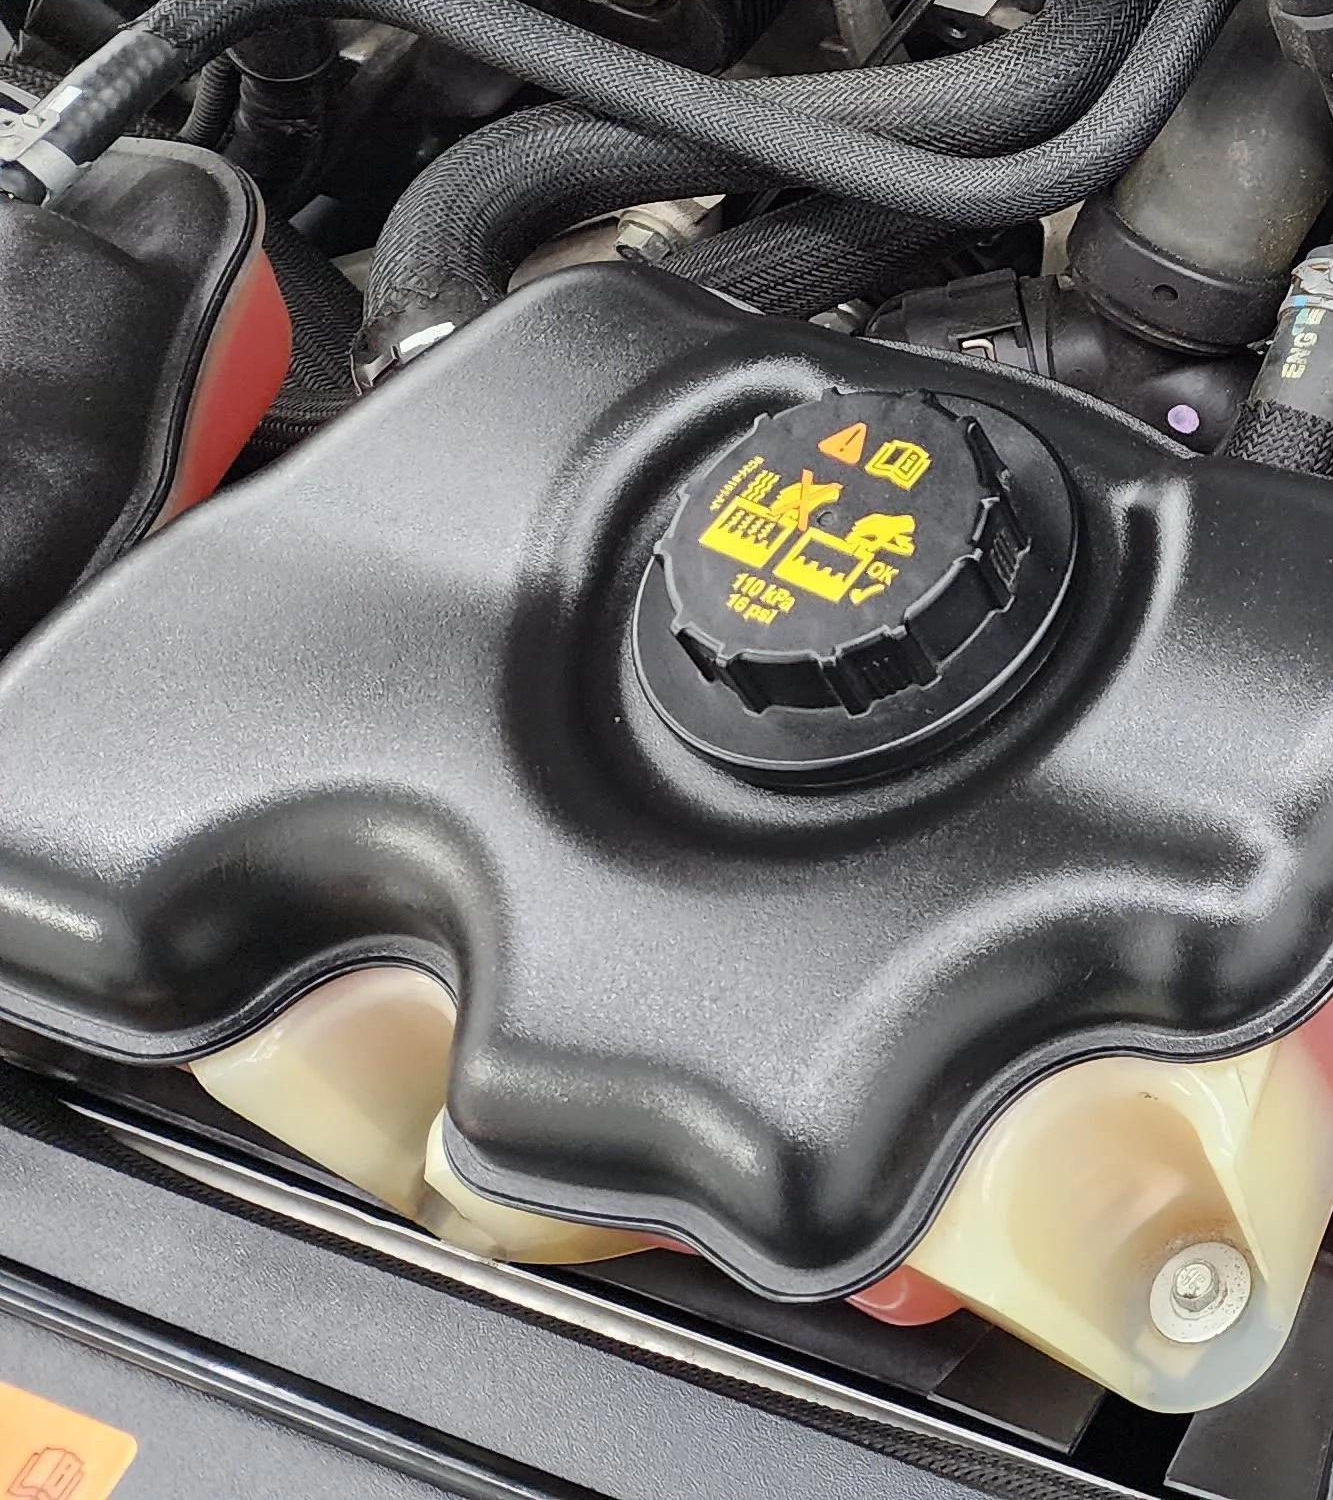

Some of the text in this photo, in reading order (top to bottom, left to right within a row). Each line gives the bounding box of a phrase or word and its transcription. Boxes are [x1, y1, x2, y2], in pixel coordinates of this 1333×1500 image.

[866, 560, 899, 587] OK
[726, 592, 779, 627] 16 psi
[732, 572, 796, 614] 110 kPa
